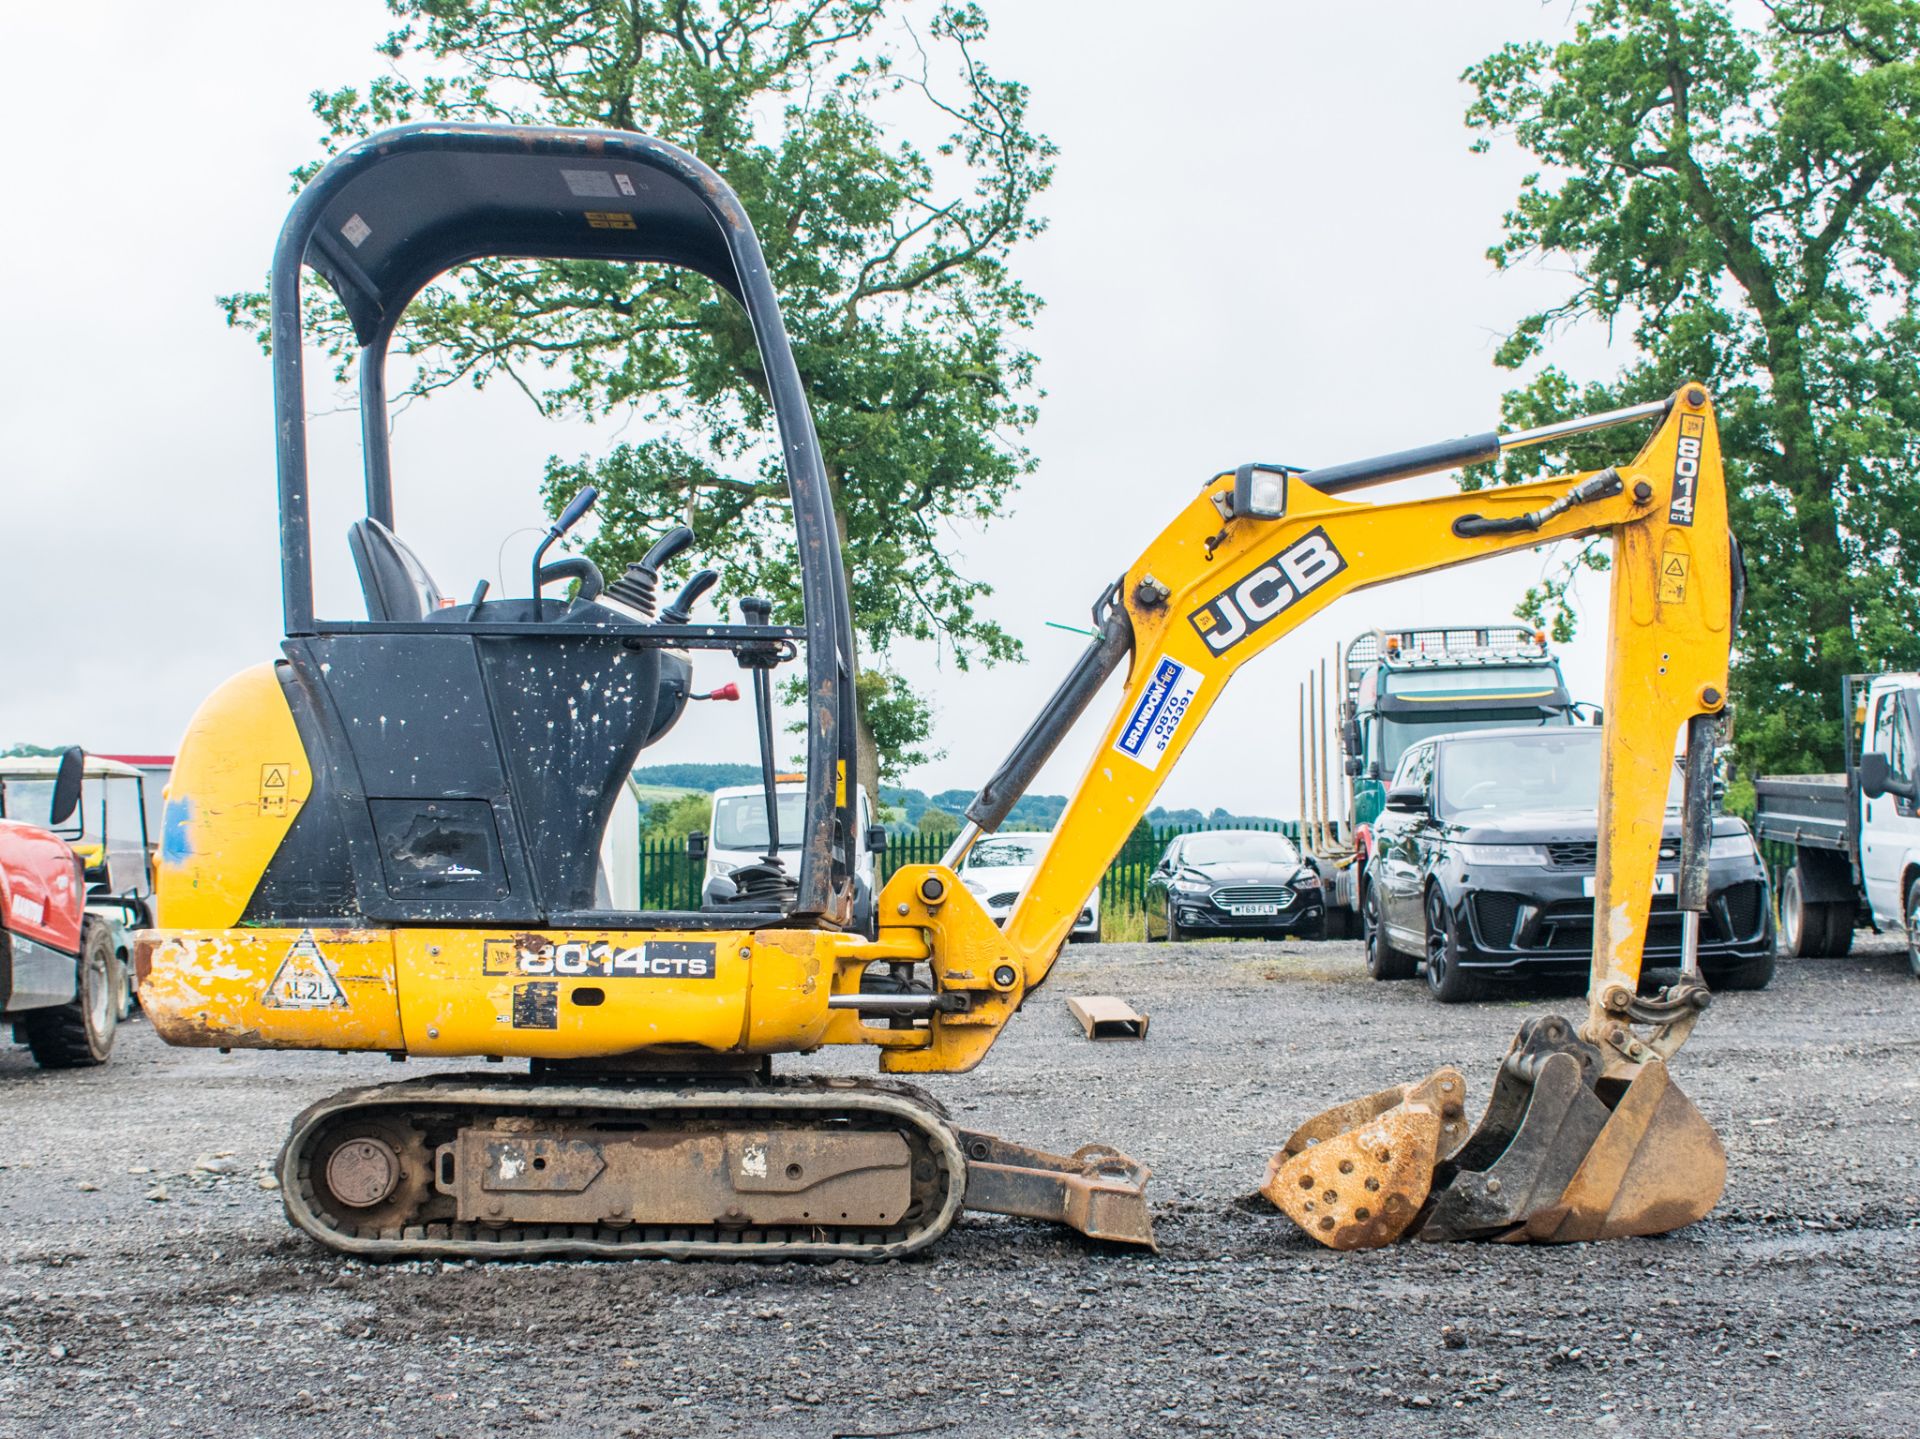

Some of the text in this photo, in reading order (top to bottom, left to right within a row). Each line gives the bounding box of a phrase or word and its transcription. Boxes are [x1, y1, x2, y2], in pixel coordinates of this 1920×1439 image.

[1671, 437, 1700, 515] 8014
[1206, 535, 1340, 649] JCB
[1154, 696, 1179, 735] 0870
[1157, 689, 1194, 751] 5143391
[1235, 905, 1257, 914] MT69
[519, 943, 707, 975] 8014 CTS
